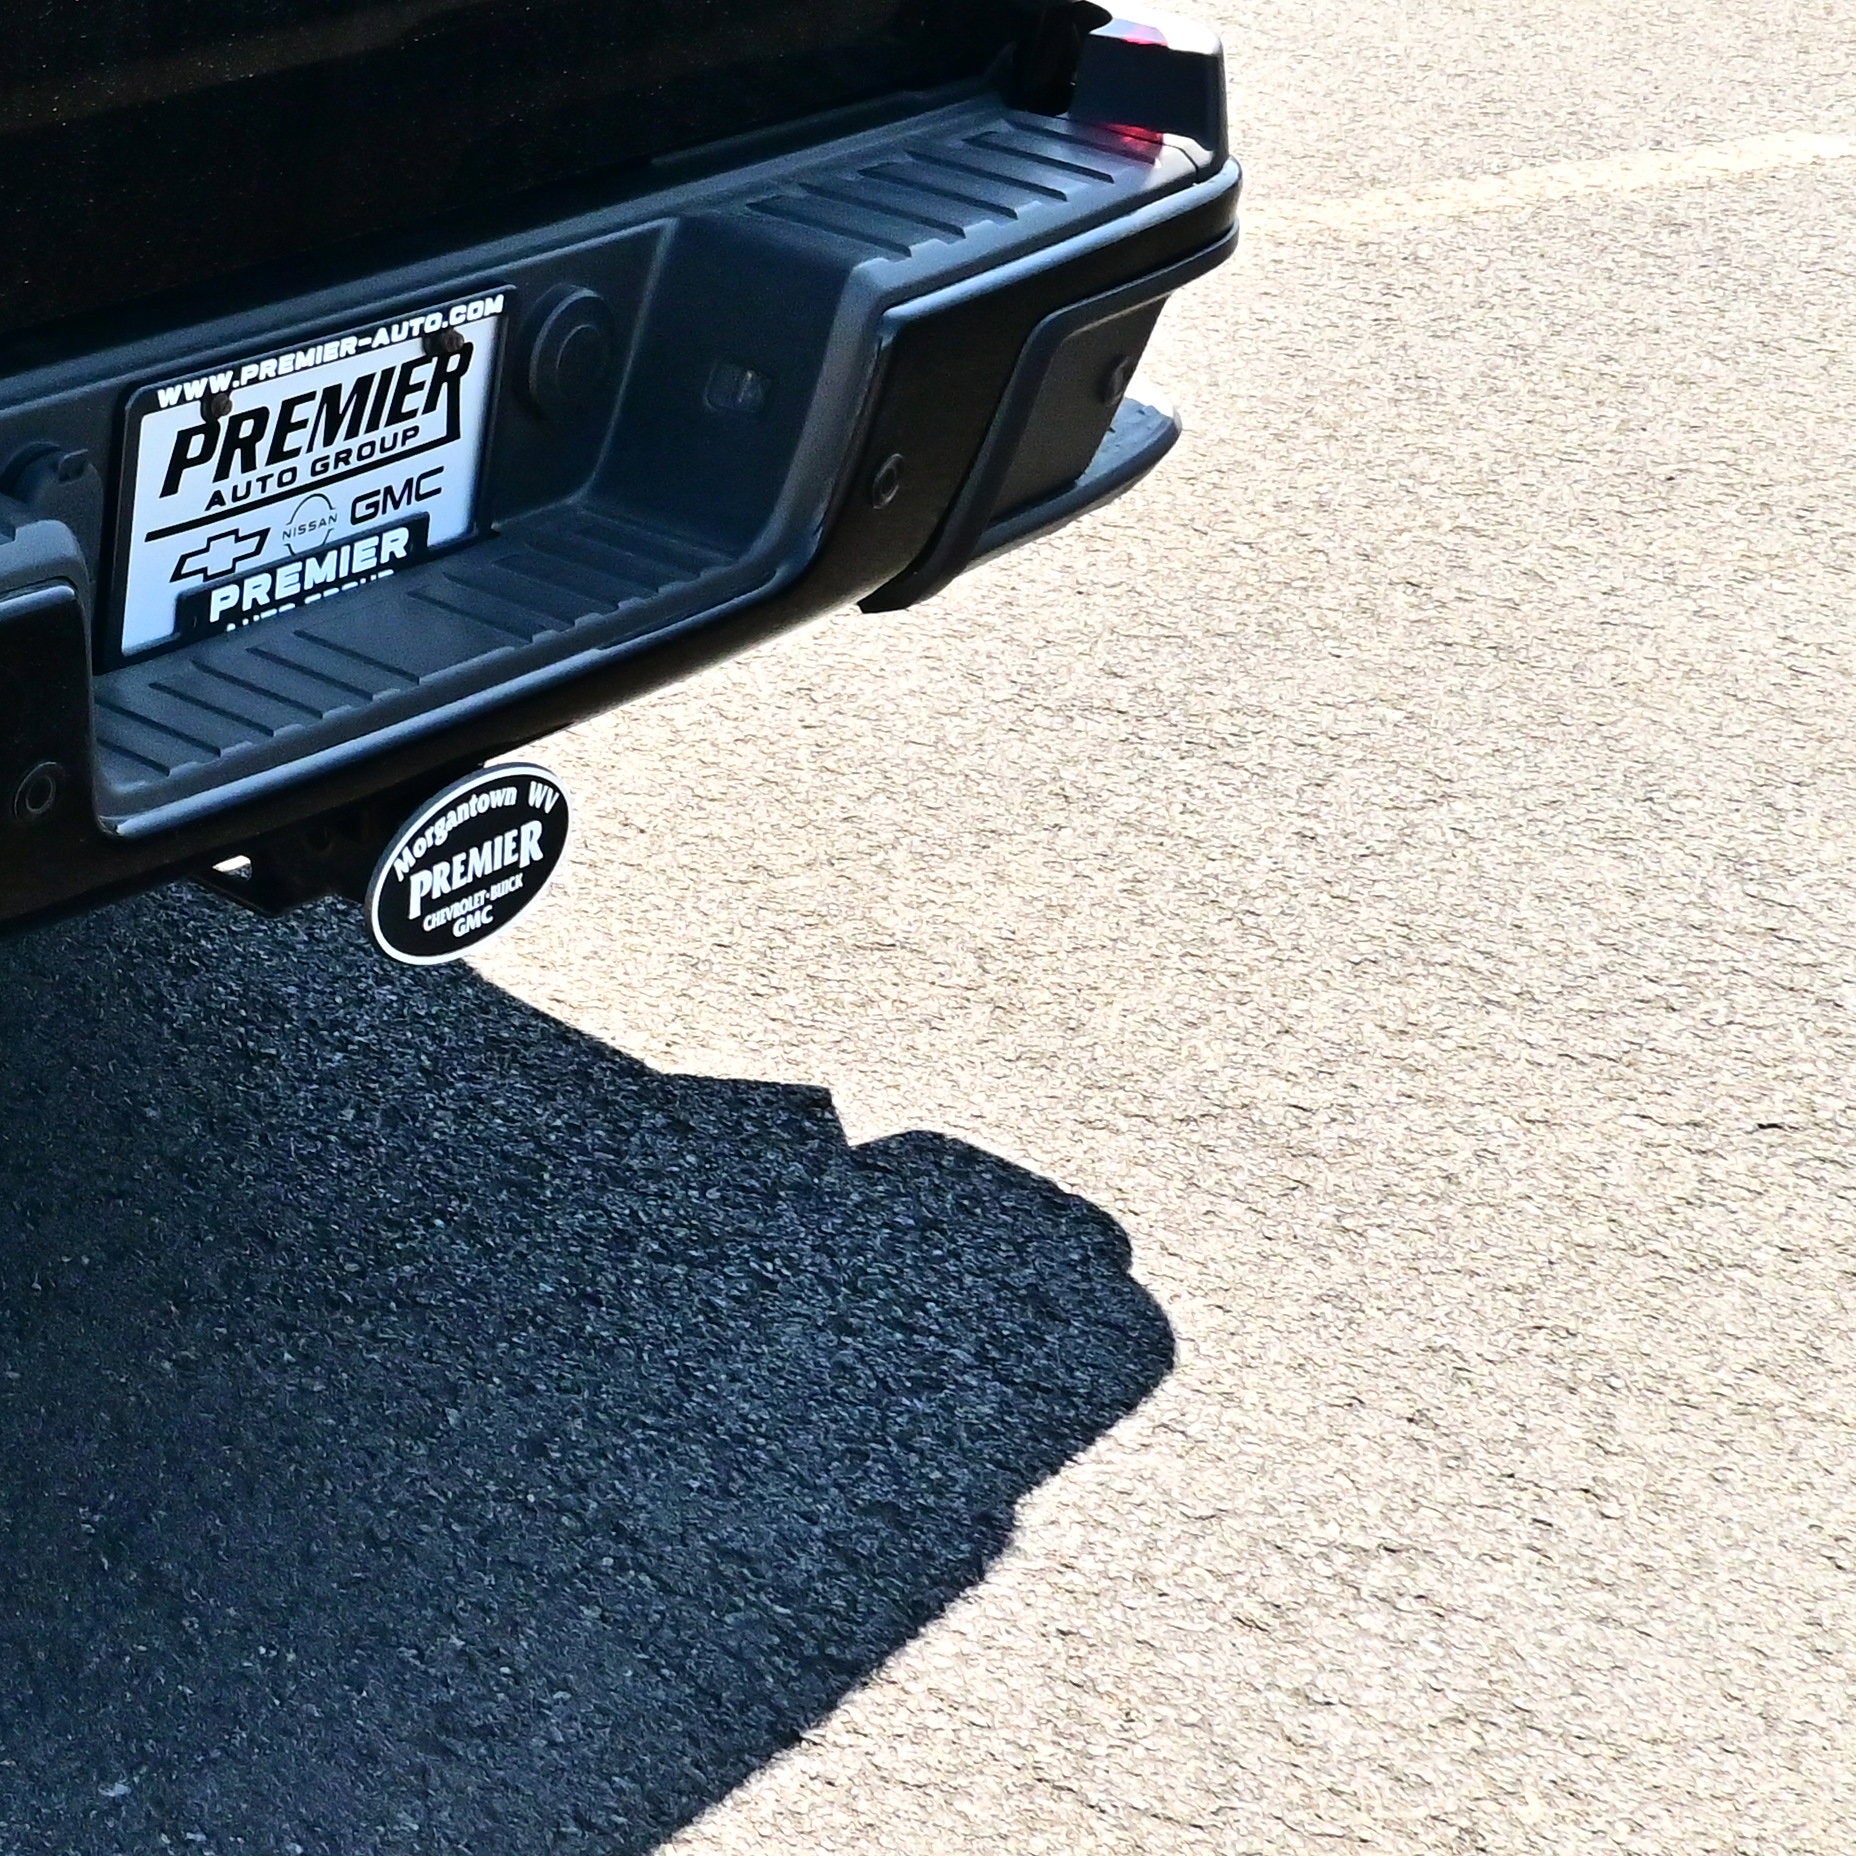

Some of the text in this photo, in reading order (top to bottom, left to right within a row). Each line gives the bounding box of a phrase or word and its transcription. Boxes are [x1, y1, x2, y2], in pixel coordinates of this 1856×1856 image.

[156, 293, 506, 409] WWW.PREMIER-AUTO.COM
[158, 341, 475, 499] PREMIER
[204, 425, 421, 512] AUTO GROUP
[282, 512, 338, 540] NISSAN
[350, 466, 445, 526] GMC
[209, 526, 410, 623] PREMIER
[393, 780, 560, 882] Morgantown WV
[408, 819, 544, 920] PREMIER
[452, 904, 495, 938] GMC
